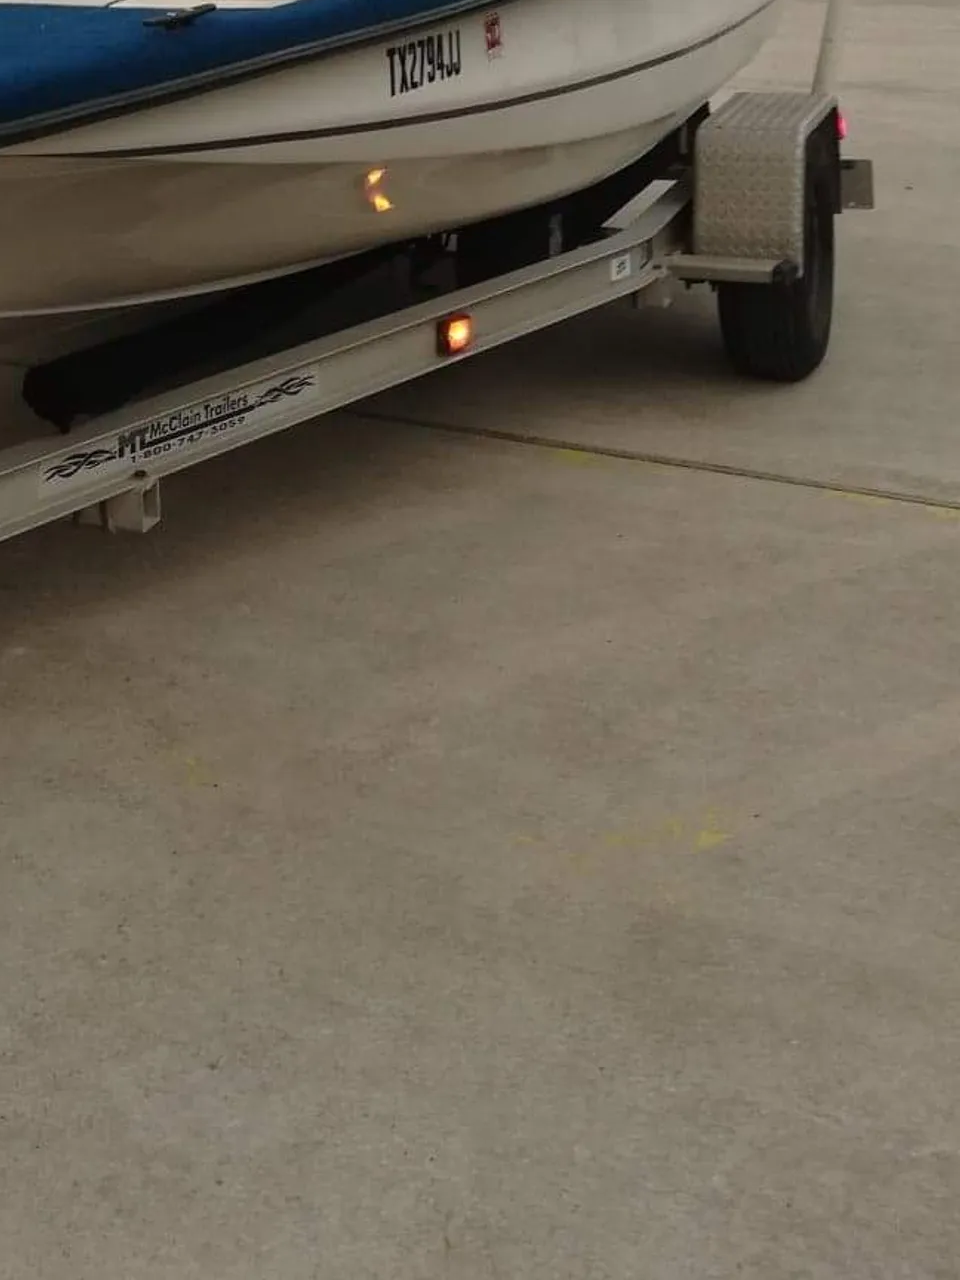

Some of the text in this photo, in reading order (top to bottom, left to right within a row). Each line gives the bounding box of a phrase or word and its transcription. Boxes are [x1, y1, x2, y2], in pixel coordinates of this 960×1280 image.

[386, 29, 461, 97] TX2794JJ
[149, 394, 249, 439] McClain Trailers
